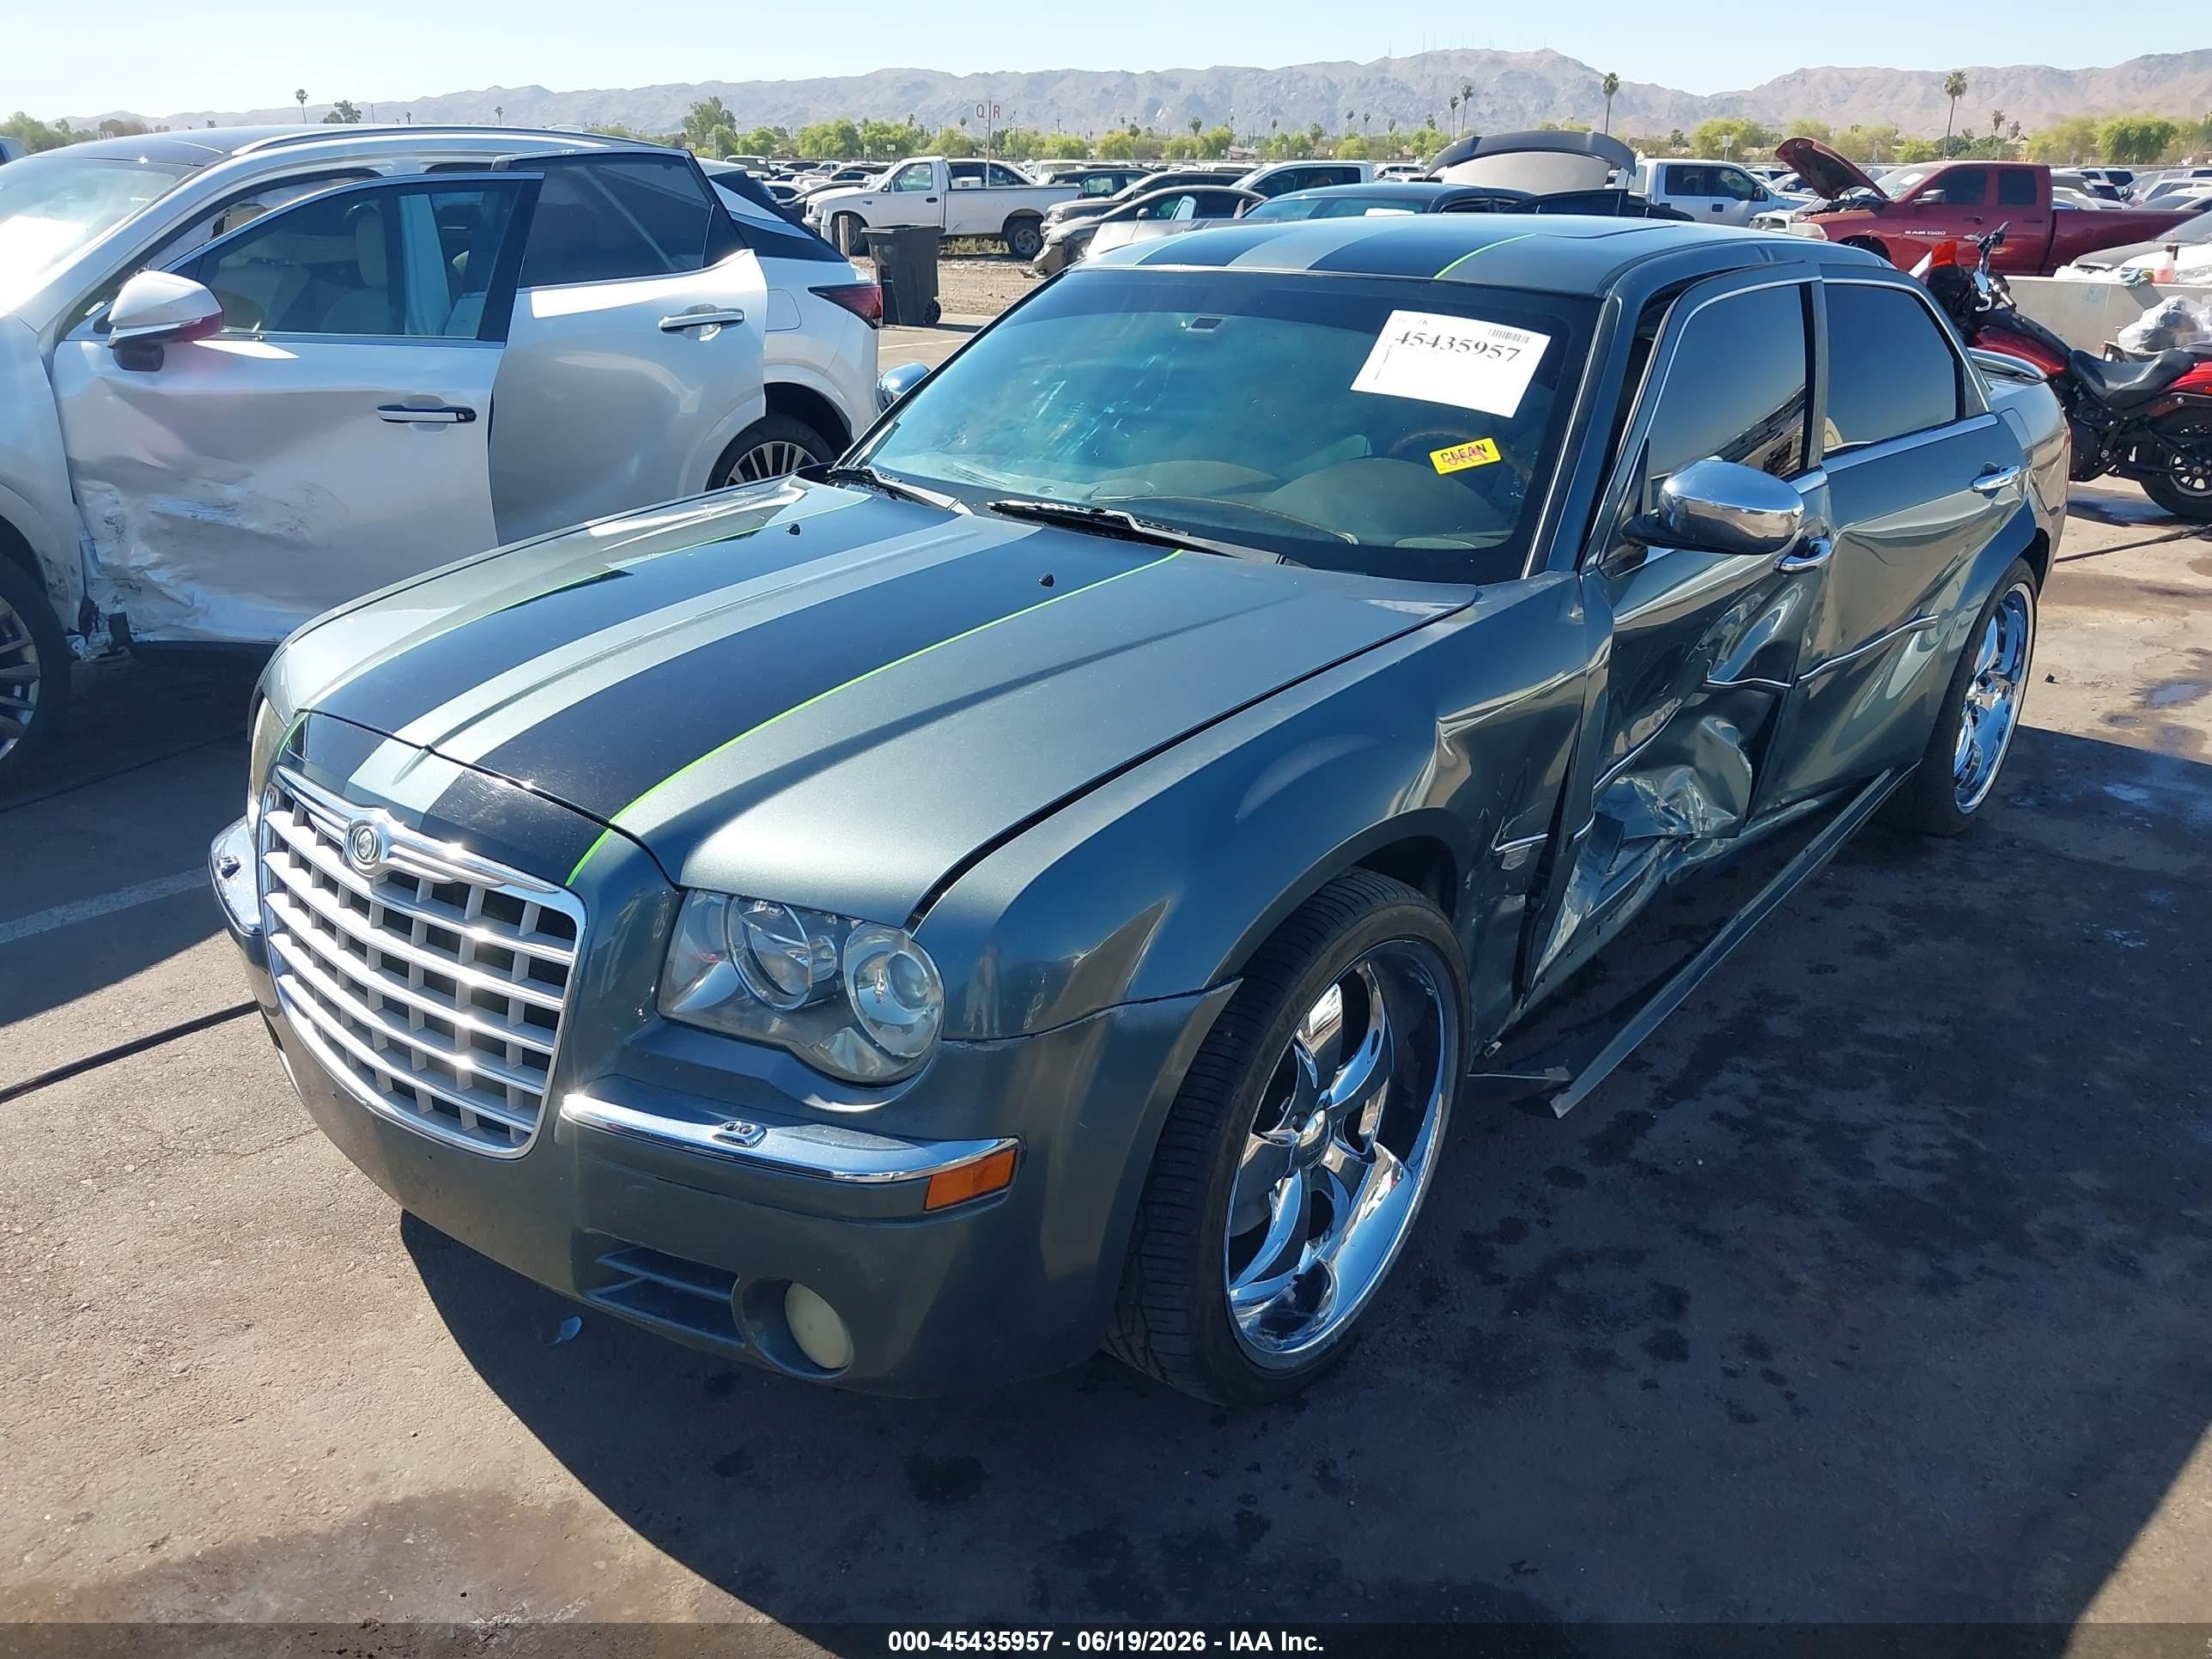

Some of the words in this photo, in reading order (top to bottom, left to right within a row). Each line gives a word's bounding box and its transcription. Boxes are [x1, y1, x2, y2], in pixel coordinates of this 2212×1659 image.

[975, 104, 985, 118] Q
[993, 105, 1000, 118] R
[1395, 330, 1522, 362] 45435957
[1440, 443, 1487, 464] CLEAN
